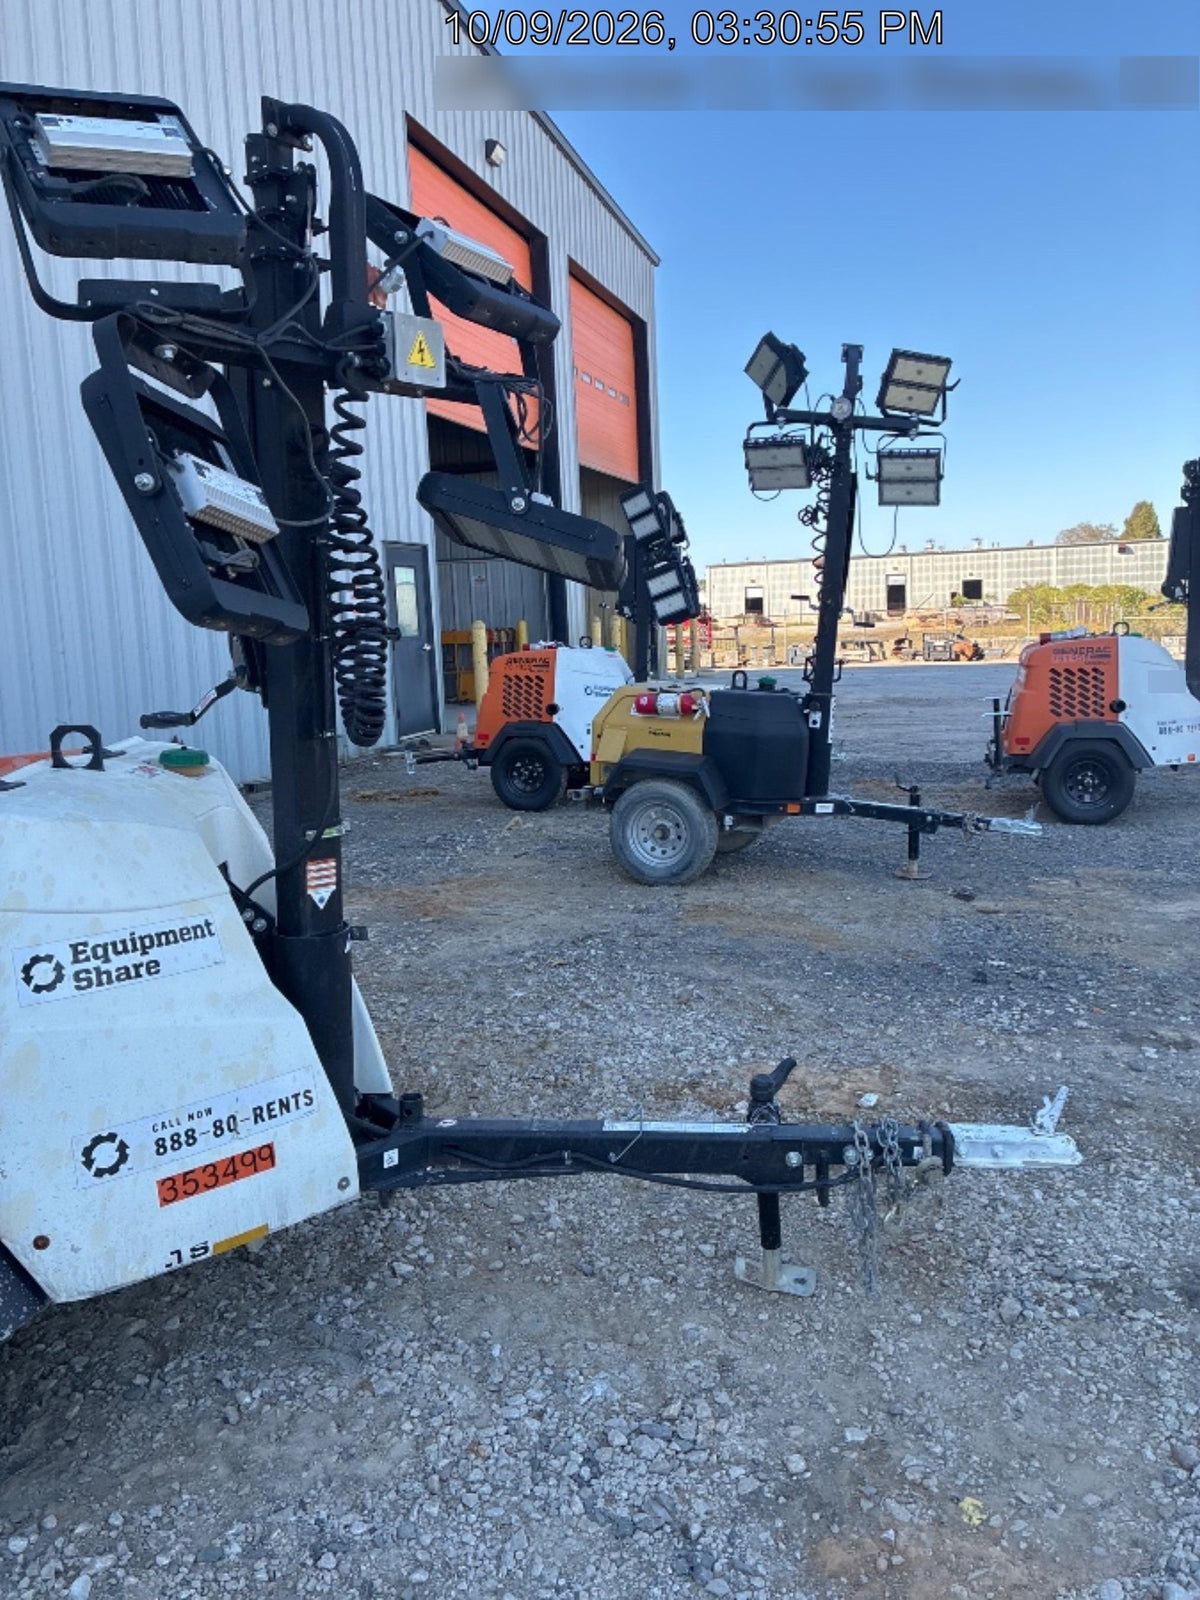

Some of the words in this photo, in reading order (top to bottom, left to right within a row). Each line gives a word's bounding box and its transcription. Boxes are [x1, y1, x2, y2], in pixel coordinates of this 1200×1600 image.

[69, 918, 216, 965] Equipment
[72, 959, 161, 991] Share
[152, 1117, 181, 1133] CALL
[187, 1107, 213, 1123] NOW
[154, 1089, 314, 1157] 888-80-RENTS
[160, 1143, 276, 1204] 353499
